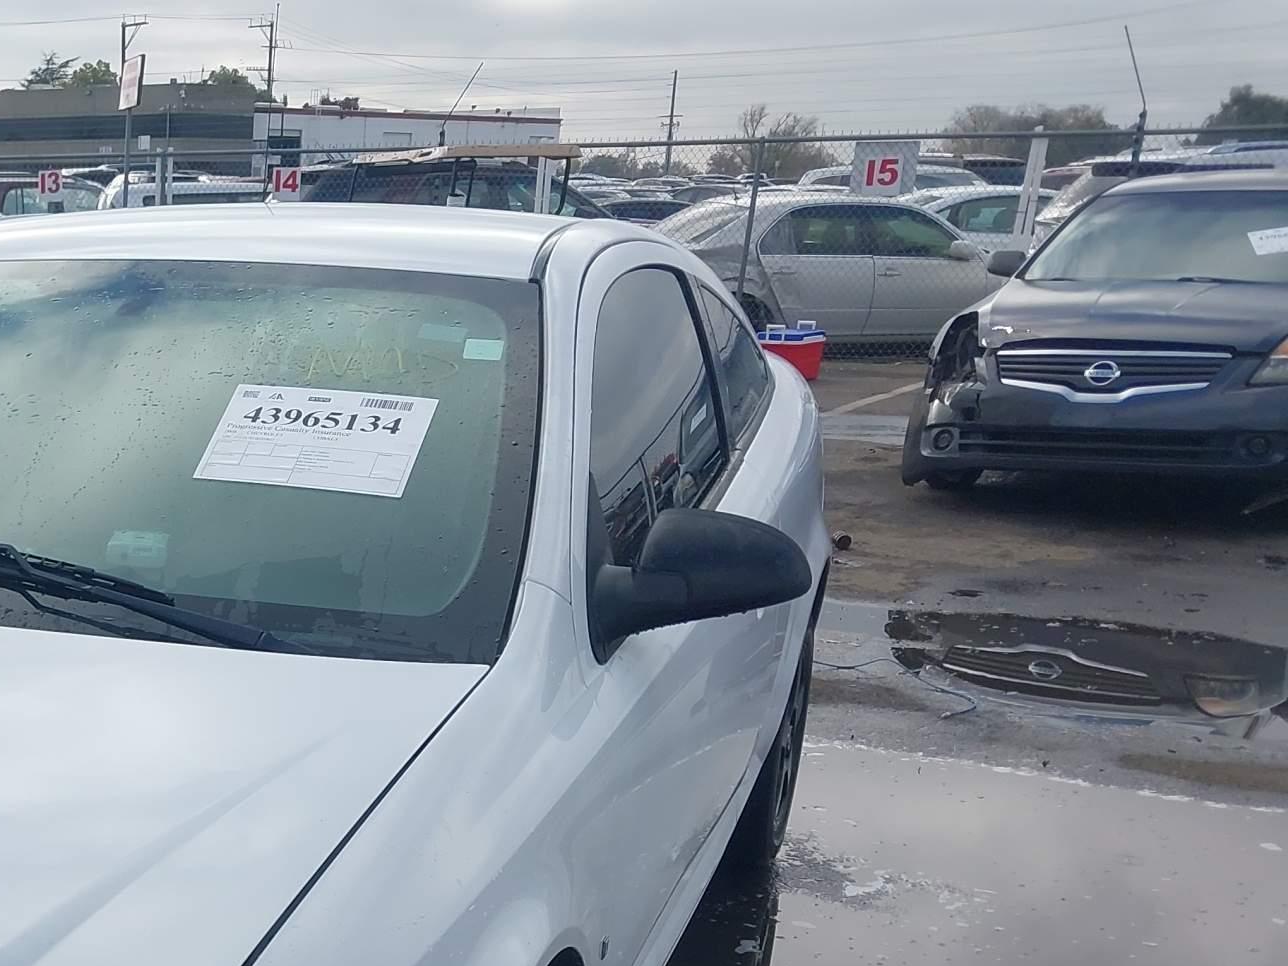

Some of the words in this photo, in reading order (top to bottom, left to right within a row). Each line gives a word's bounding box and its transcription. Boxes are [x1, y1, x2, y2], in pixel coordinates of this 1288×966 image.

[40, 172, 61, 194] 13
[274, 169, 299, 193] 14
[865, 158, 899, 187] 15
[226, 422, 274, 432] Progressive
[311, 428, 352, 438] Insurance
[243, 406, 403, 435] 43965134
